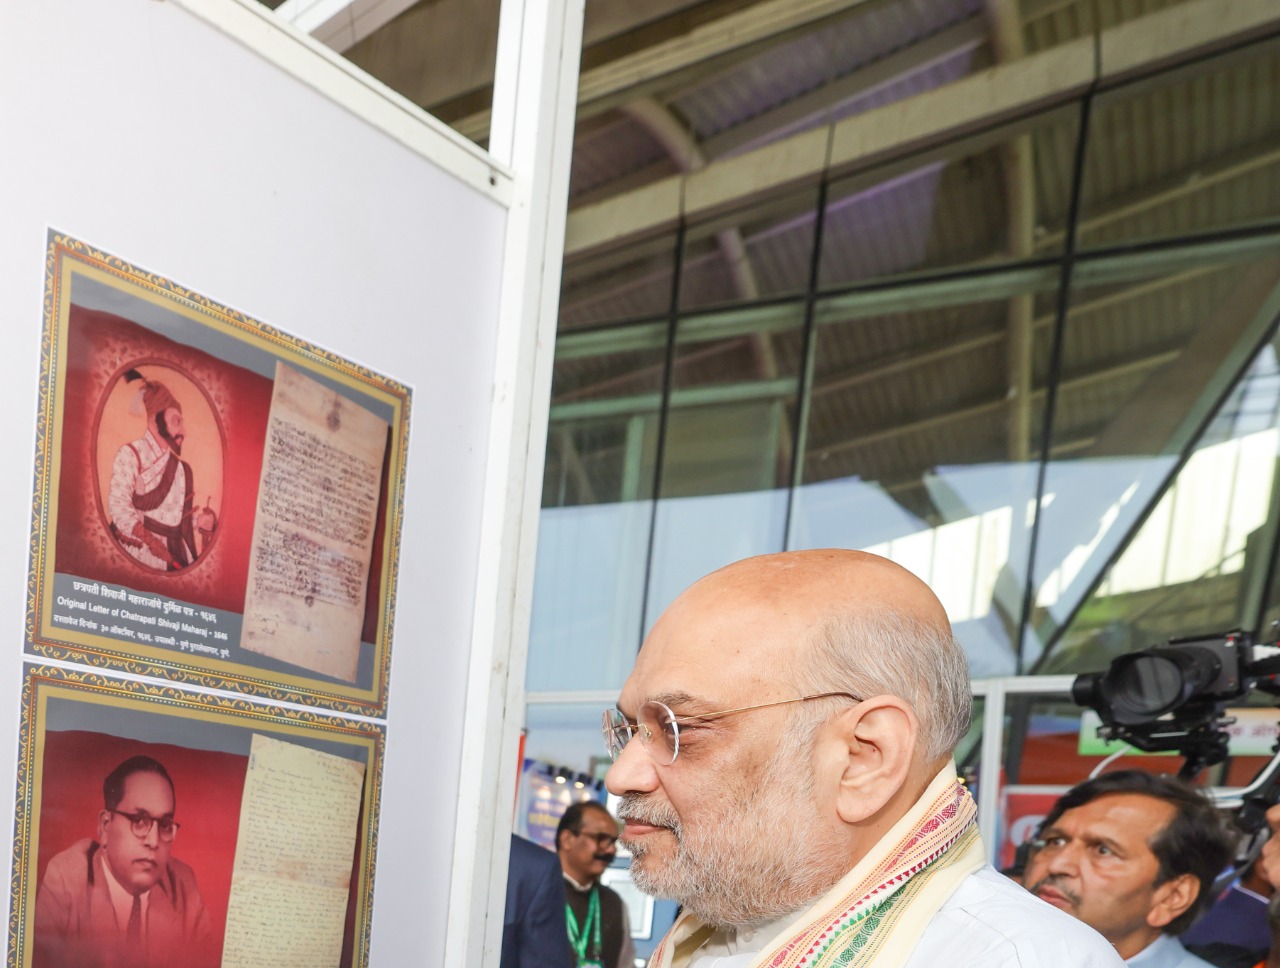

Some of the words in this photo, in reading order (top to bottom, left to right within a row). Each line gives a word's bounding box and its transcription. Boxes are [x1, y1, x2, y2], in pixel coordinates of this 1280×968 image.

[57, 596, 87, 609] Original
[88, 602, 110, 614] Letter
[111, 608, 119, 616] of
[158, 618, 180, 631] Shivaji
